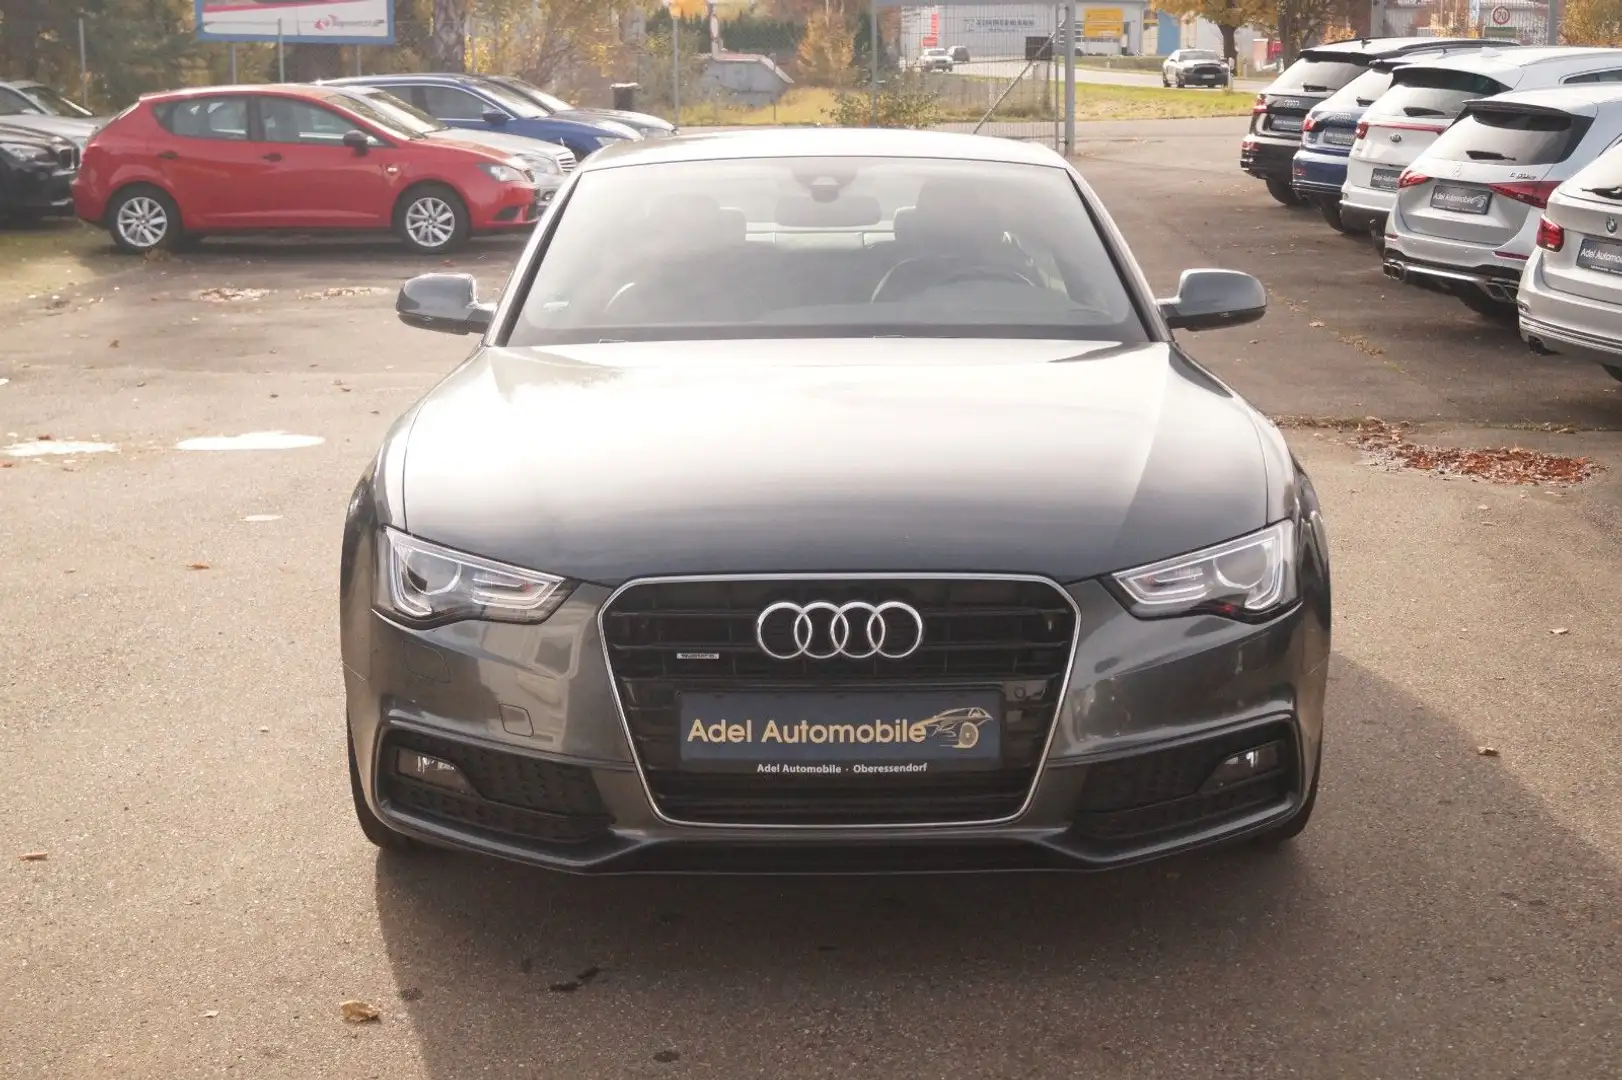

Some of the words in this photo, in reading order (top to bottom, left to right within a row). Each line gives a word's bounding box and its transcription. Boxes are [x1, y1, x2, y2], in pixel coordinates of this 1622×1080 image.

[1432, 192, 1445, 200] Adel
[1581, 248, 1596, 258] Adel
[687, 718, 752, 743] Adel
[760, 719, 927, 744] Automobile
[757, 763, 780, 773] Adel
[782, 763, 842, 774] Automobile
[853, 763, 928, 774] Oberessendorf
